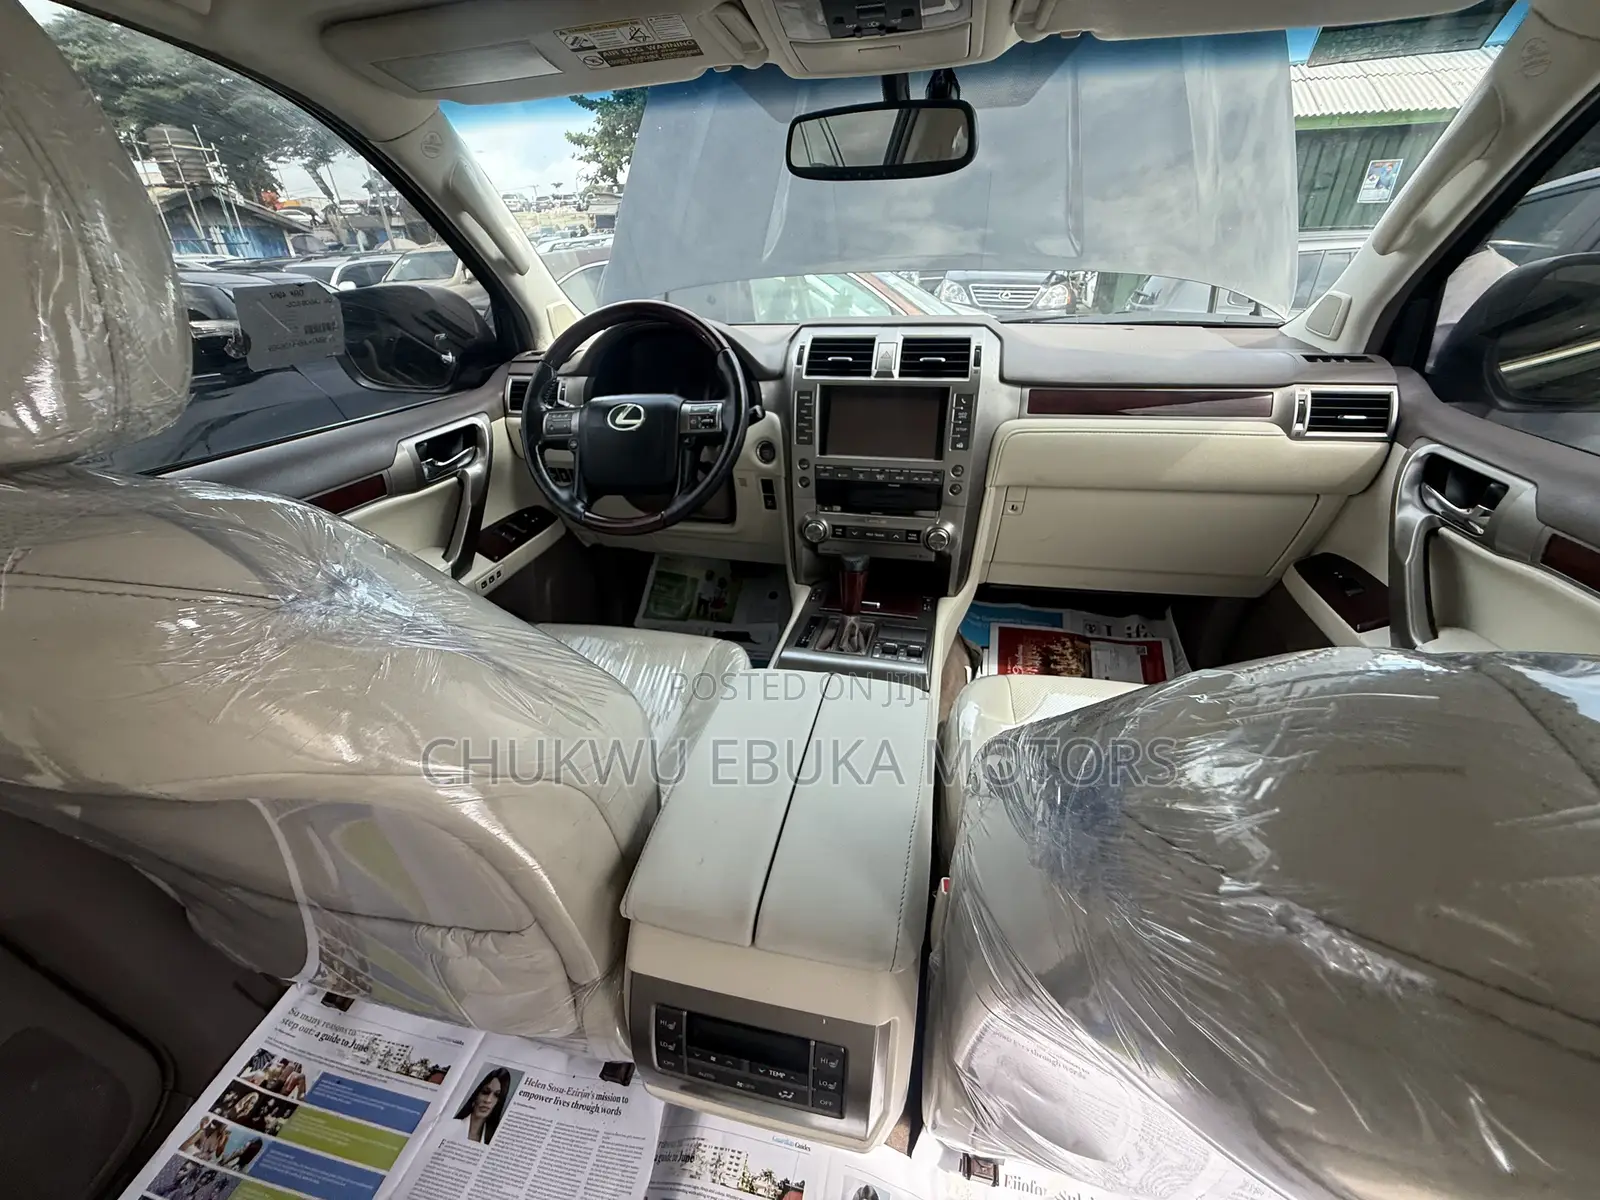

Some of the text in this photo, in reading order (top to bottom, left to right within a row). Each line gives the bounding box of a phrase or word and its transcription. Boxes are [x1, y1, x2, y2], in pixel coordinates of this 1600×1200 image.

[602, 49, 620, 57] AIR
[621, 46, 644, 54] BAG
[646, 40, 695, 51] WARNING
[1104, 623, 1157, 639] Lif
[288, 1006, 299, 1017] So
[300, 1013, 320, 1027] many
[322, 1021, 347, 1034] reasons
[280, 1017, 299, 1031] step
[299, 1024, 315, 1036] out:
[319, 1032, 341, 1044] guide
[341, 1037, 349, 1047] to
[349, 1037, 369, 1053] June
[769, 1069, 786, 1079] TEMP
[519, 1090, 553, 1105] empower
[553, 1096, 570, 1108] lives
[571, 1100, 601, 1115] through
[600, 1106, 622, 1116] words
[524, 1077, 547, 1090] Helen
[595, 1092, 621, 1104] mission
[622, 1096, 629, 1104] to
